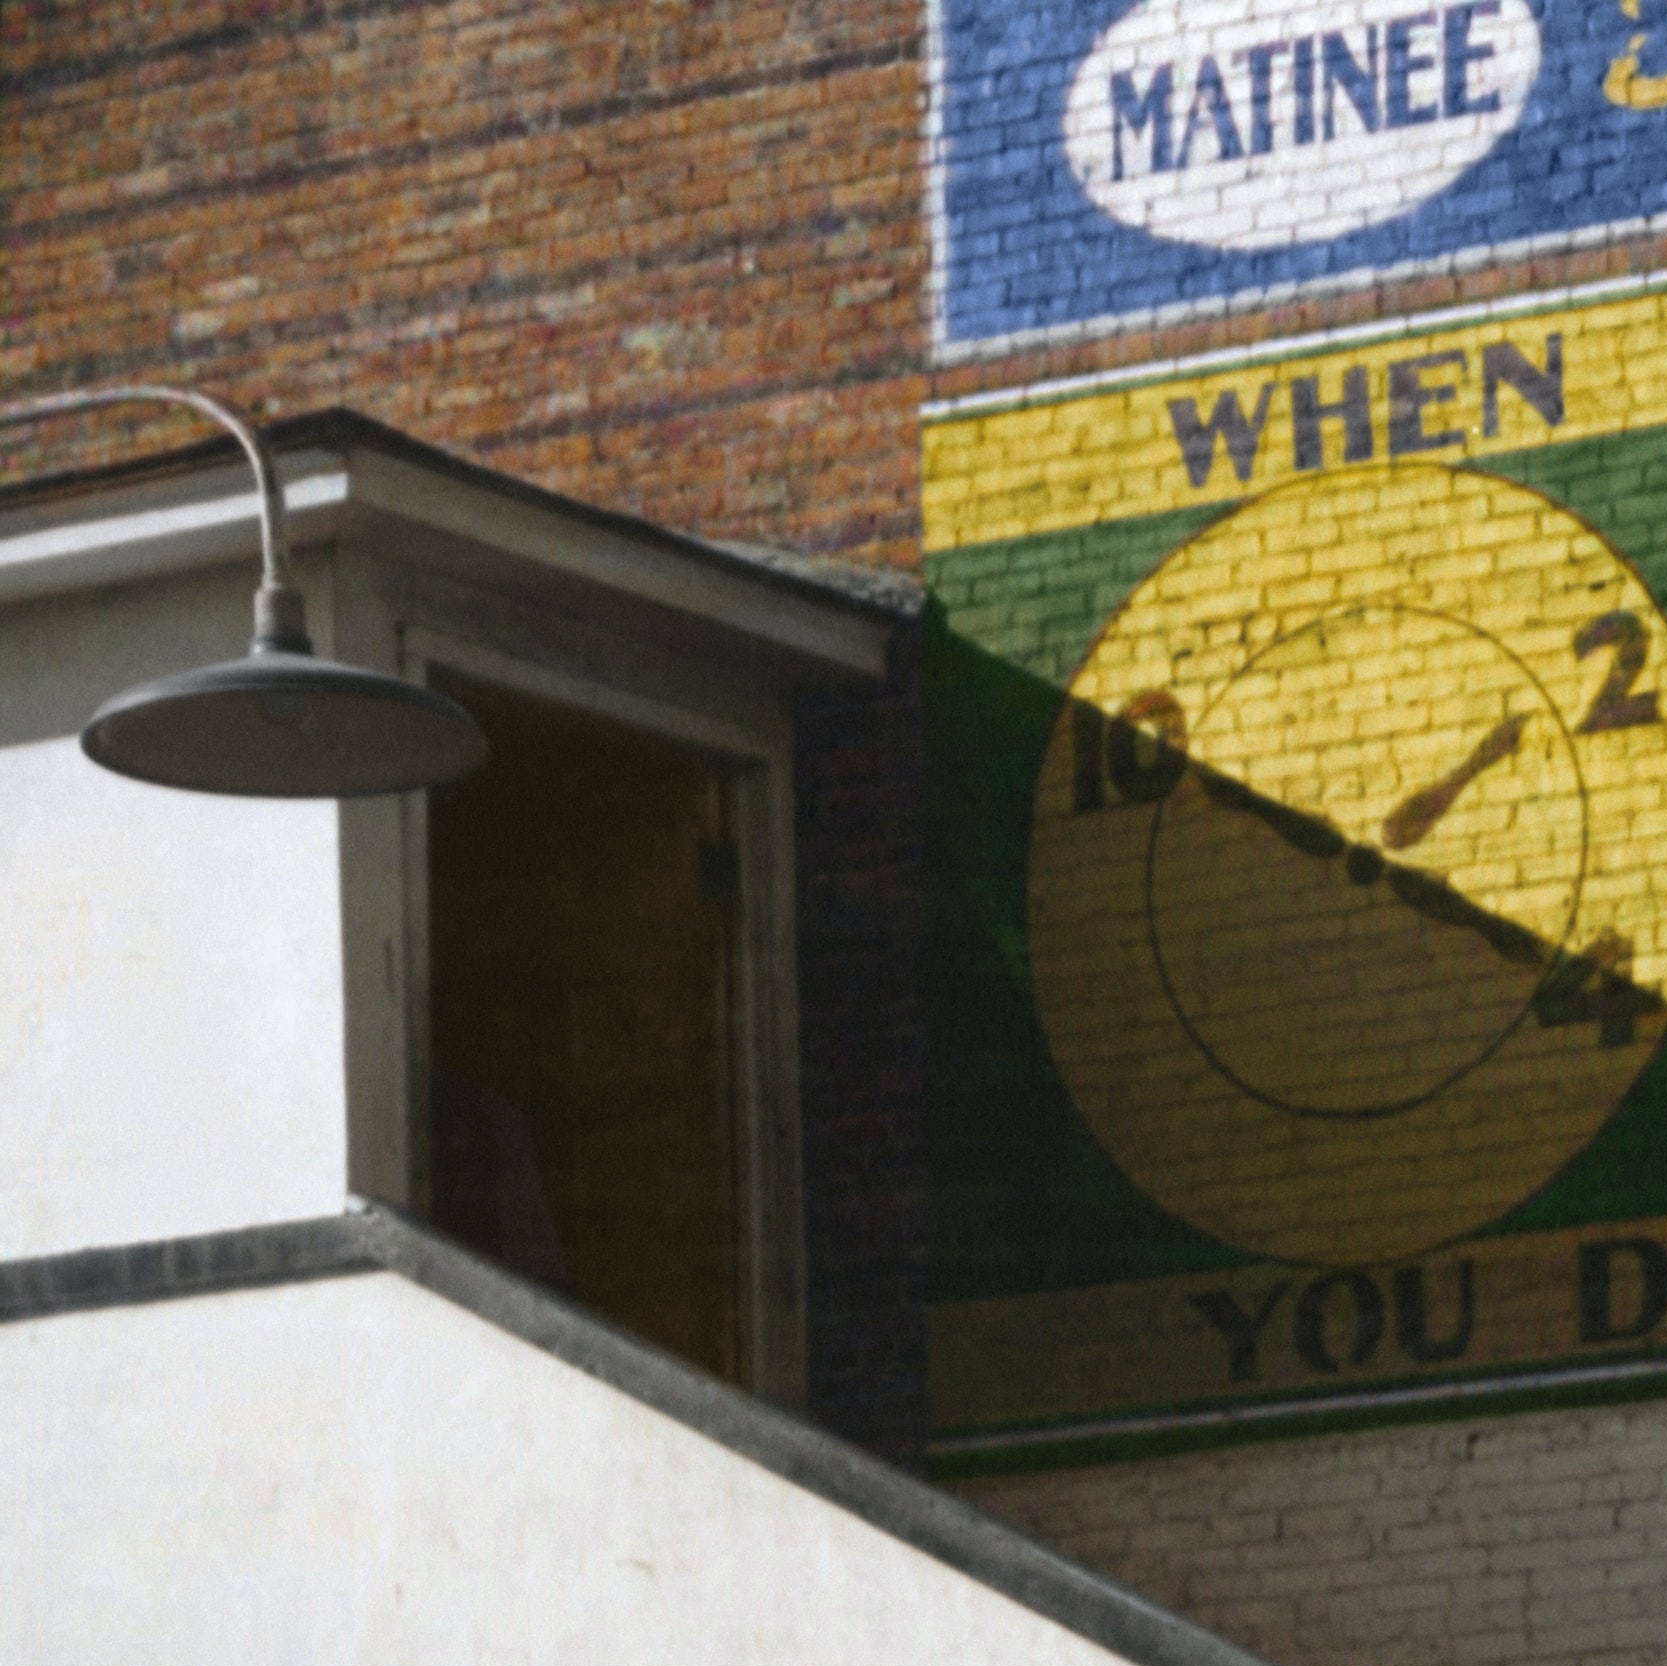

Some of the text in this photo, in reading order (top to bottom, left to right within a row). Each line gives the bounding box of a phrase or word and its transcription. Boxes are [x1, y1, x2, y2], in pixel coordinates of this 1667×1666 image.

[1110, 0, 1501, 182] MATINEE
[1168, 333, 1567, 487] WHEN
[1571, 611, 1660, 733] 2
[1072, 688, 1188, 815] 10
[1191, 1260, 1476, 1380] YOU
